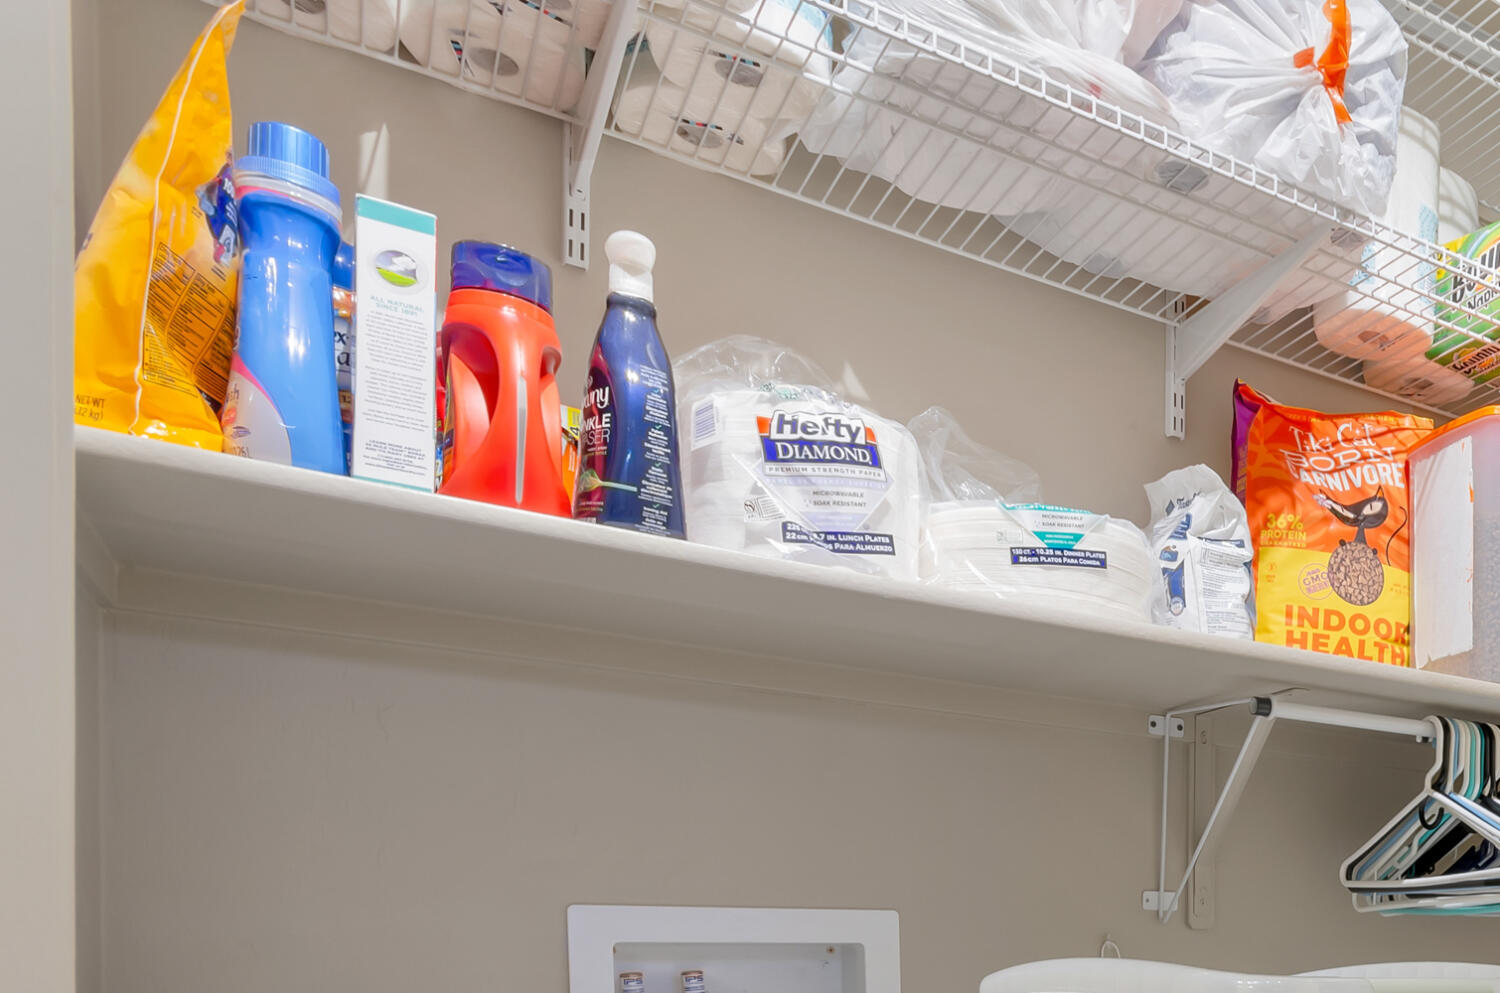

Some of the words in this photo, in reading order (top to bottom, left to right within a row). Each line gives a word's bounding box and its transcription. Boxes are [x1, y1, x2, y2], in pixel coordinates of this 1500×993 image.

[775, 413, 862, 443] Hefty
[1337, 422, 1377, 448] Cat
[775, 441, 870, 463] DIAMOND
[1279, 446, 1396, 472] BORN
[812, 466, 856, 475] STRENGTH
[1266, 513, 1304, 531] 36%
[1260, 530, 1307, 541] PROTEIN
[1285, 604, 1408, 645] INDOOR
[1285, 630, 1406, 668] HEALTH
